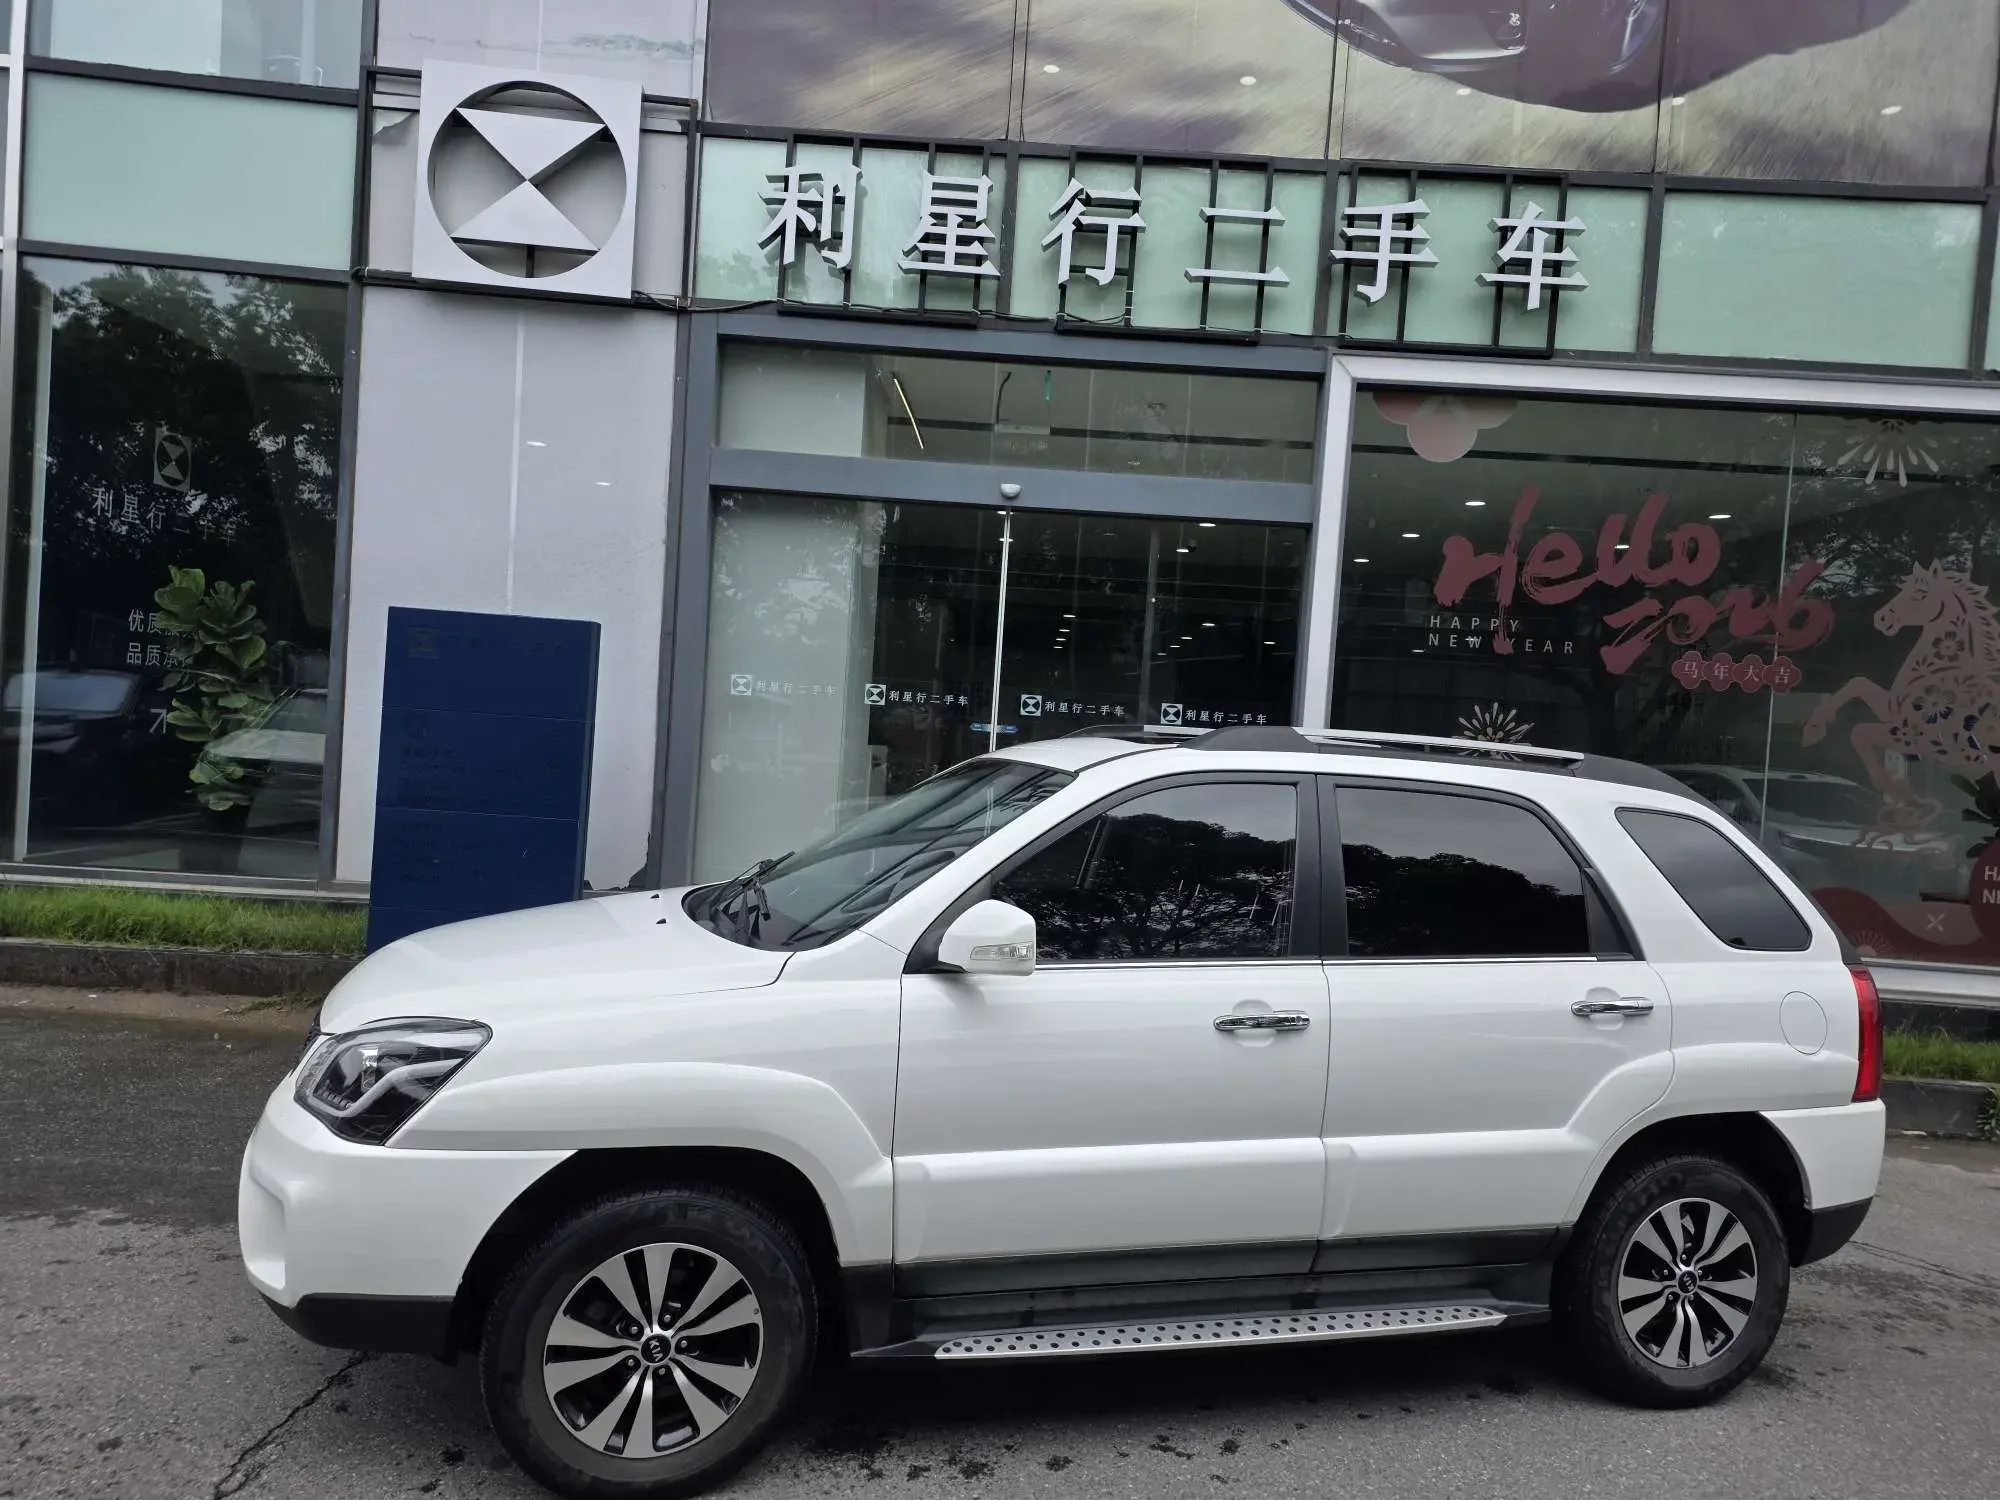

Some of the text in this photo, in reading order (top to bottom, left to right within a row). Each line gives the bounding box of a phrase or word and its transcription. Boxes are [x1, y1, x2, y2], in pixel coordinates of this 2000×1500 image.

[757, 164, 1588, 311] 利星行二手车
[1430, 615, 1520, 633] HAPPY
[1428, 633, 1482, 649] NEW
[1680, 661, 1791, 684] 马年大吉
[888, 690, 969, 707] 利星行二手车
[1044, 701, 1126, 718] 利星行二手车
[1184, 709, 1267, 725] 利星行二手车
[1984, 865, 2000, 881] H
